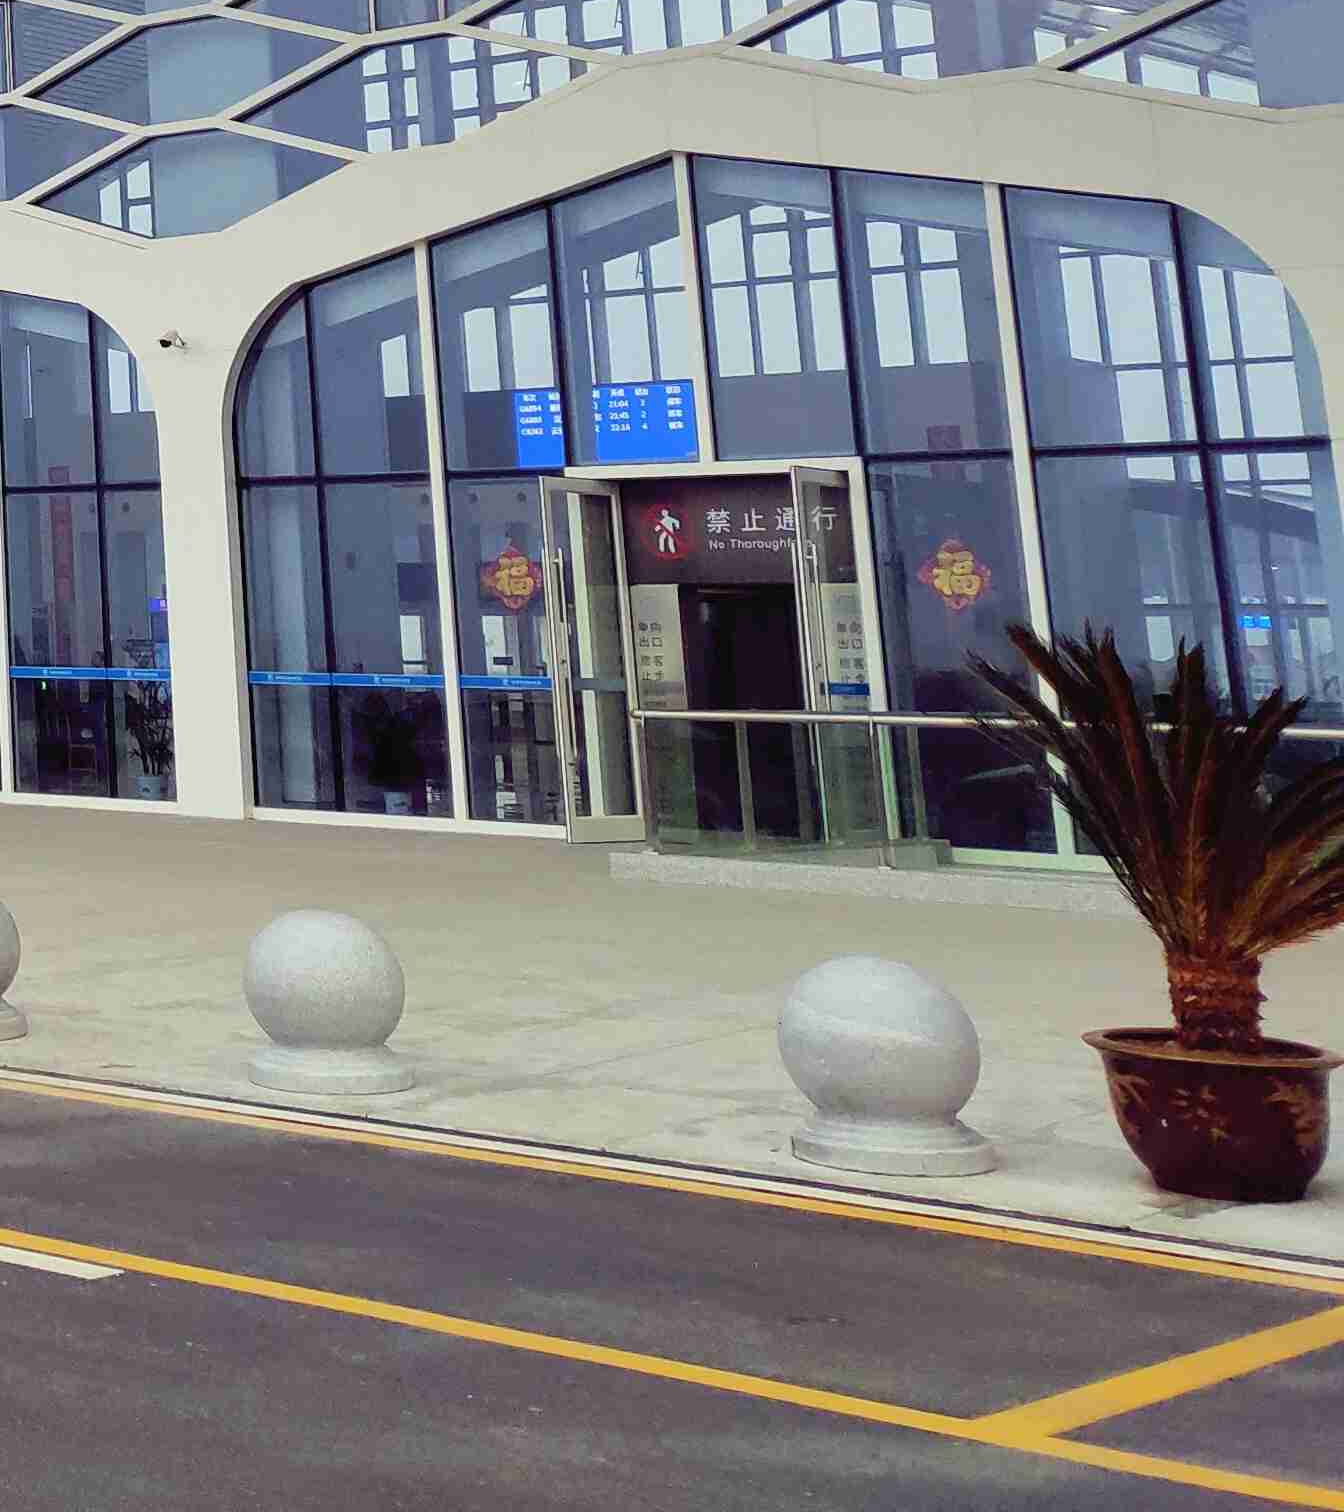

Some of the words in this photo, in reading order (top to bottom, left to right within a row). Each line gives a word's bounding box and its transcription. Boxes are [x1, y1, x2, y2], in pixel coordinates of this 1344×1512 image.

[706, 506, 838, 534] 禁止通行
[708, 539, 726, 550] No
